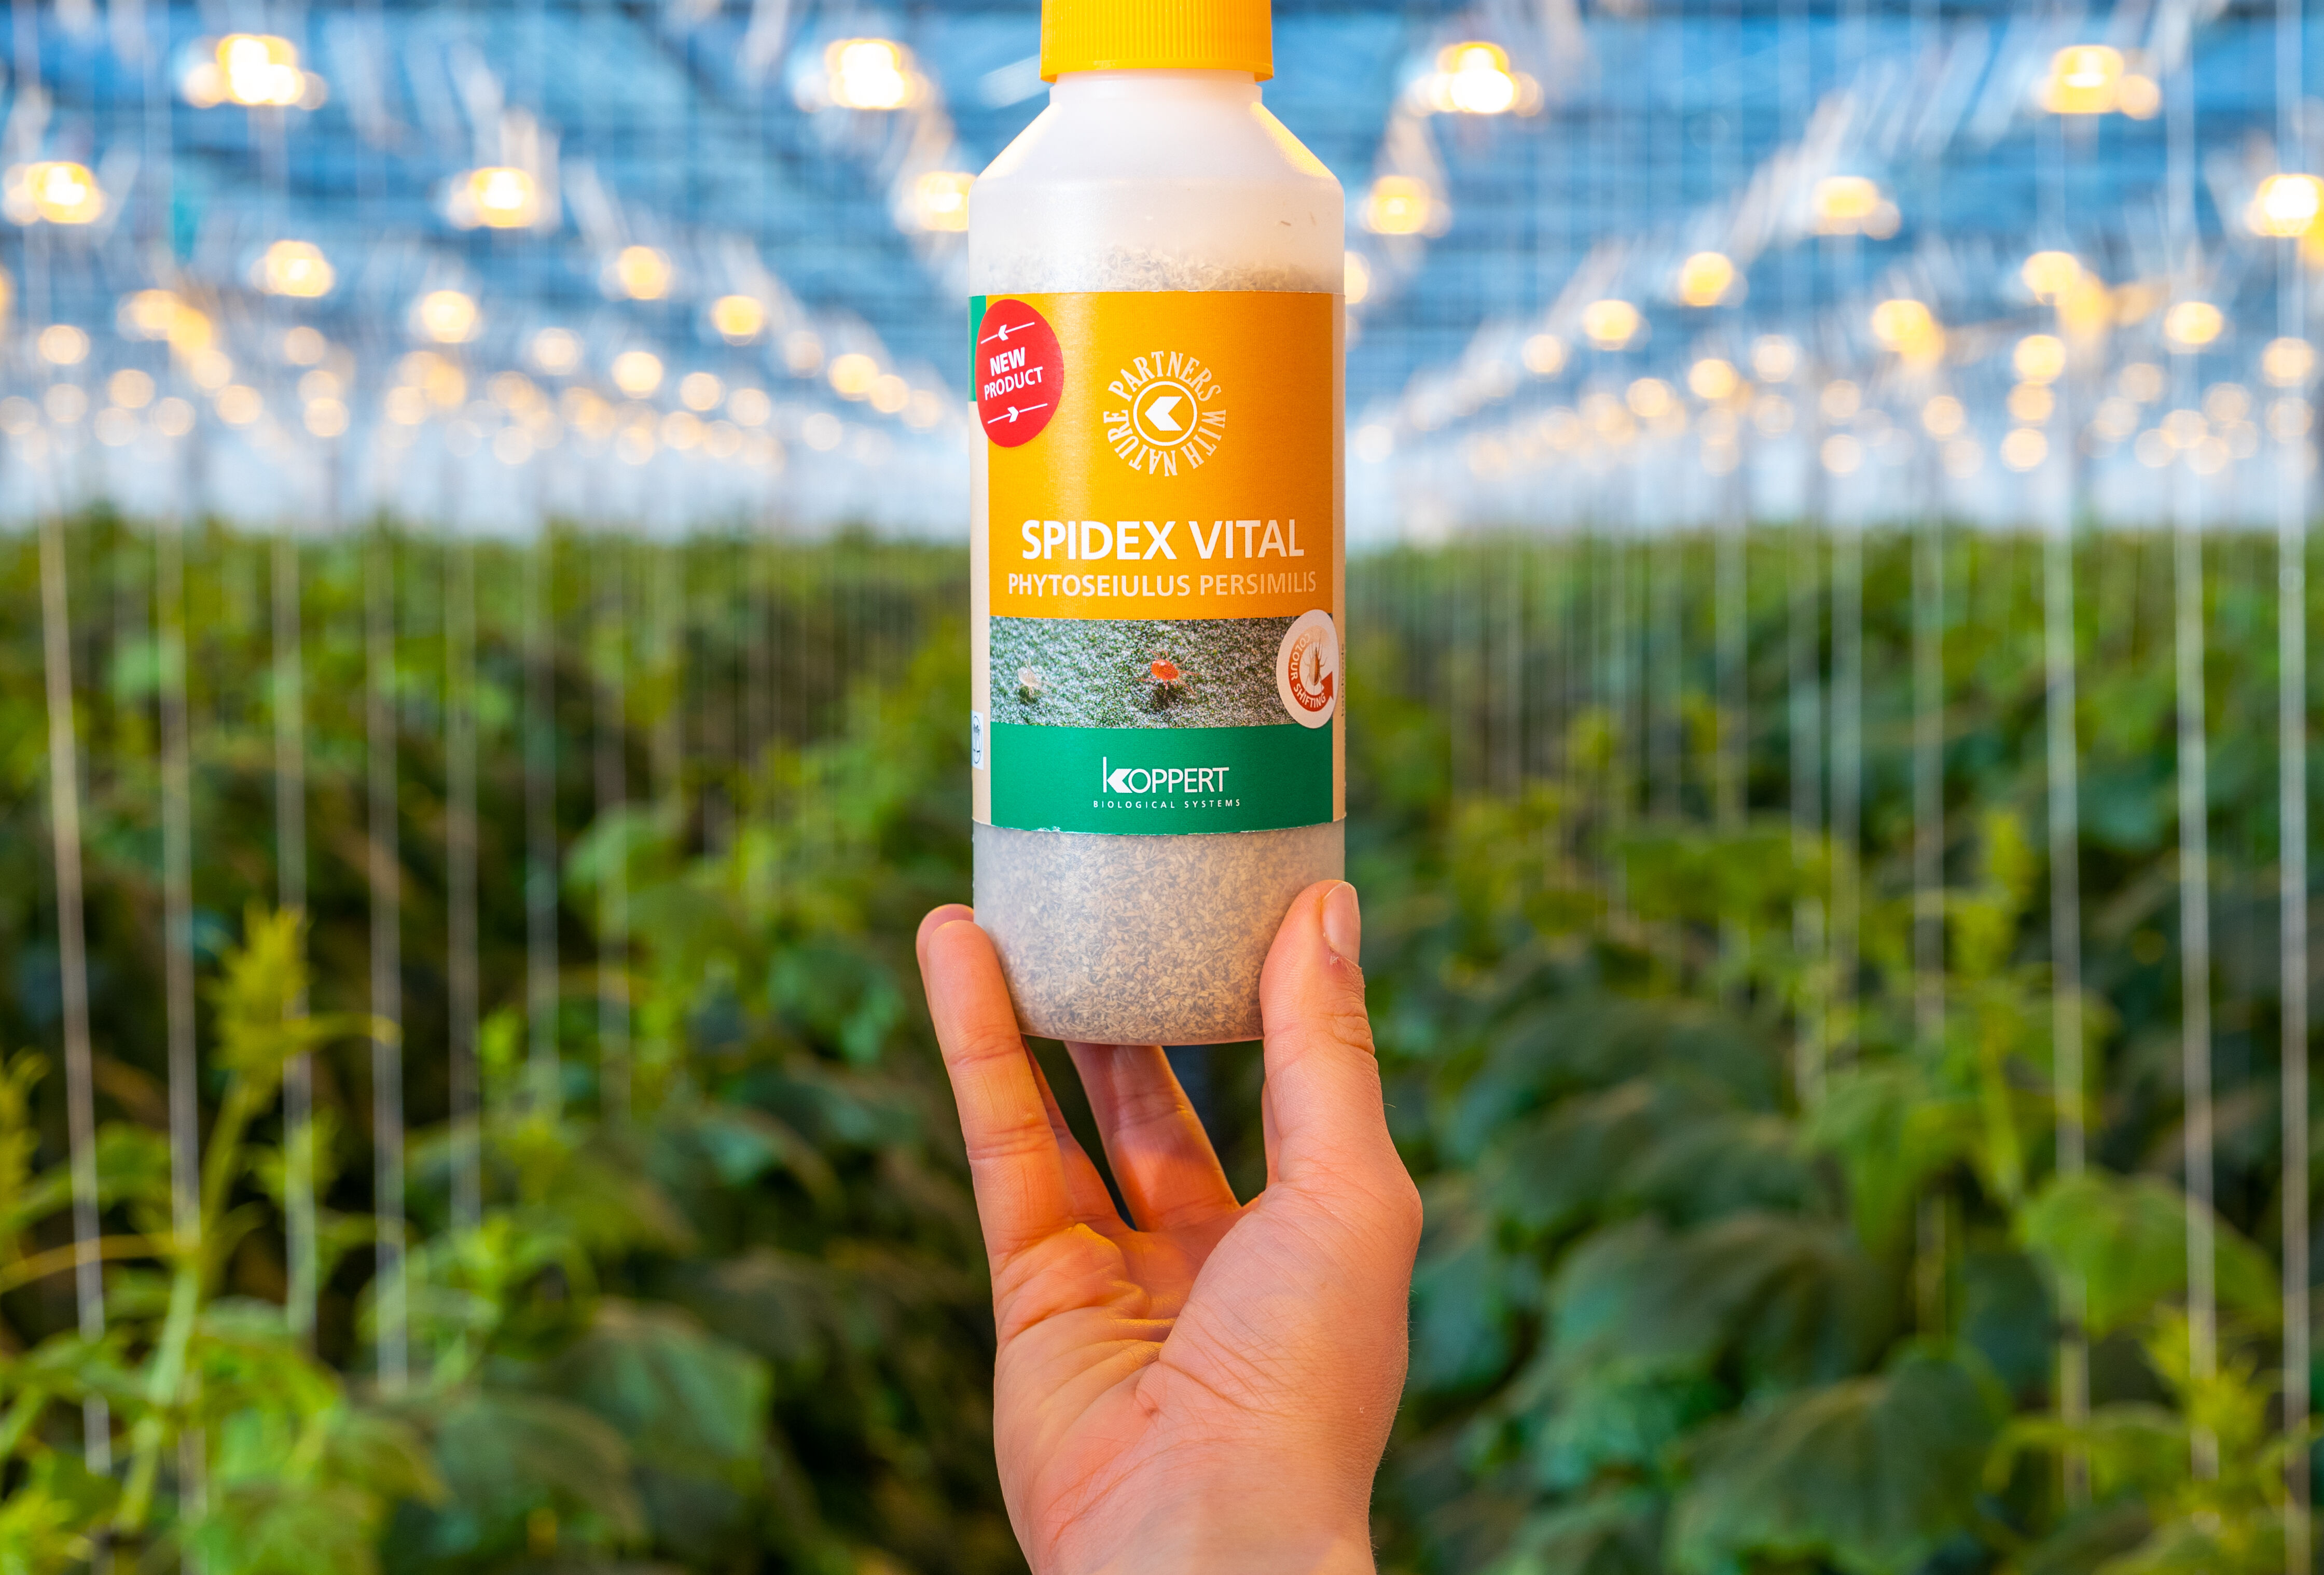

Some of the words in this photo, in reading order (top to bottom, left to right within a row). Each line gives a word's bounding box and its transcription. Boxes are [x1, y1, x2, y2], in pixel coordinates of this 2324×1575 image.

[990, 346, 1025, 377] NEW
[1108, 351, 1222, 402] PARTNERS
[984, 366, 1043, 400] PRODUCT
[1103, 410, 1178, 477] NATURE
[1181, 410, 1226, 469] WITH
[1021, 520, 1177, 560] SPIDEX
[1188, 519, 1305, 559] VITAL
[1008, 573, 1191, 597] PHYTOSEIULUS
[1200, 572, 1317, 596] PERSIMILIS
[1291, 633, 1310, 681] COLOUR
[1293, 683, 1326, 708] SHIFTING
[1103, 757, 1229, 793] KOPPERT
[1093, 800, 1175, 809] BIOLOGICAL
[1184, 799, 1241, 808] SYSTEMS
